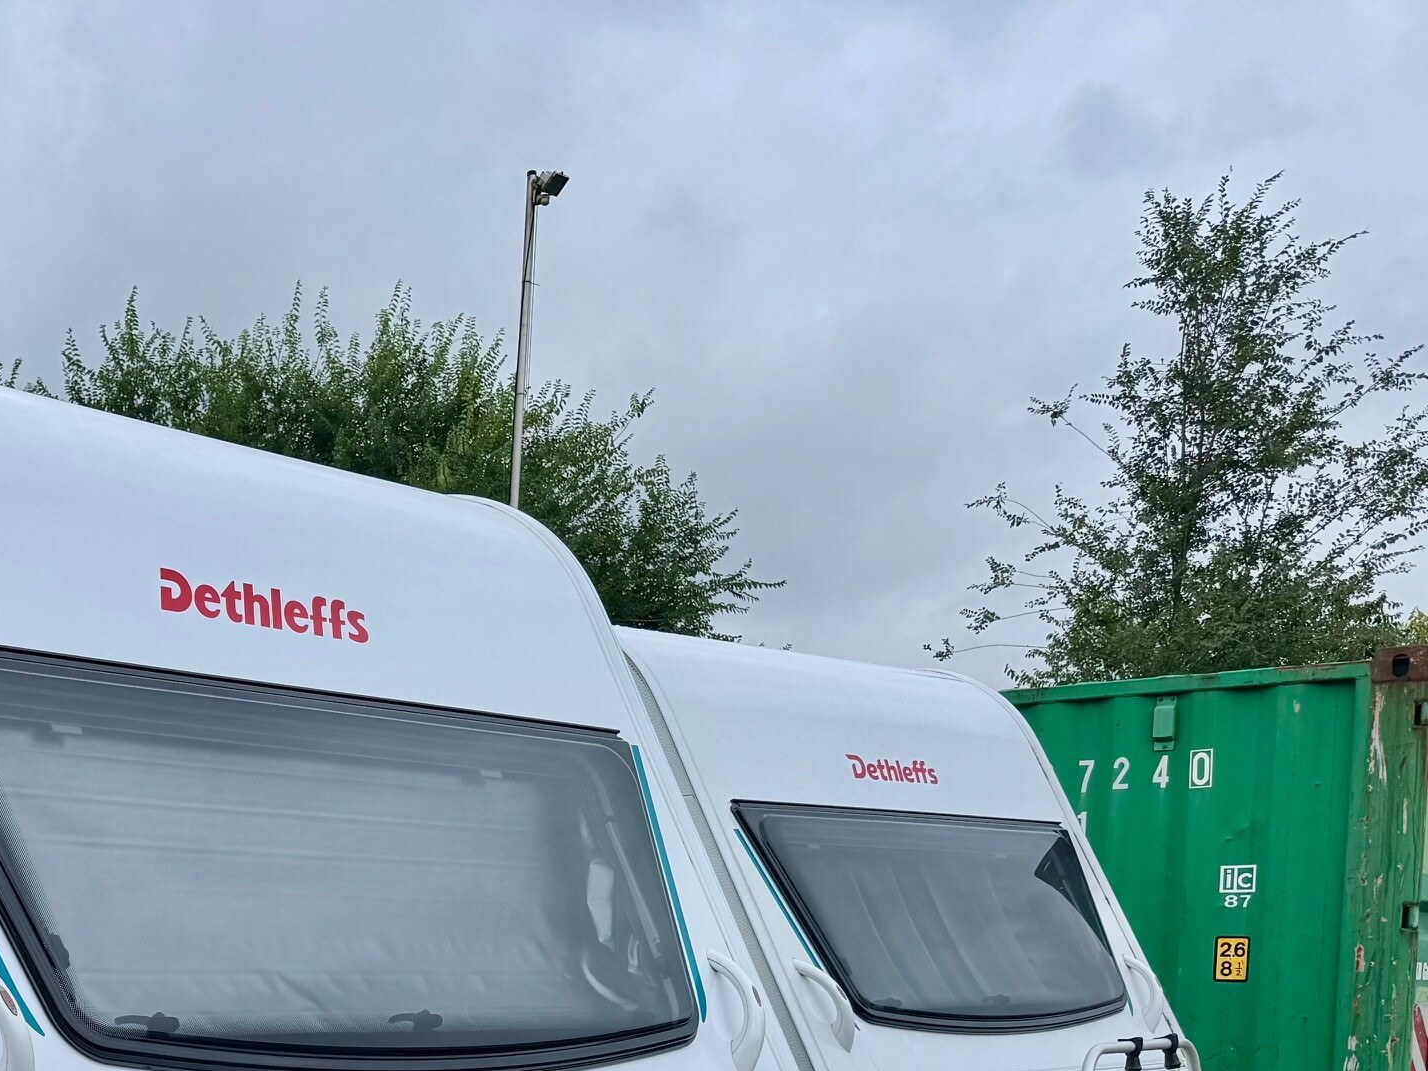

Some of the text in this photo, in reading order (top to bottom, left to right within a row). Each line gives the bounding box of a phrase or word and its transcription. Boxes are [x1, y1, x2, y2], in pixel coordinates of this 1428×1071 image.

[159, 567, 370, 643] Dethleffs
[845, 753, 939, 784] Dethleffs
[1224, 894, 1251, 908] 87
[1219, 942, 1246, 958] 2.6
